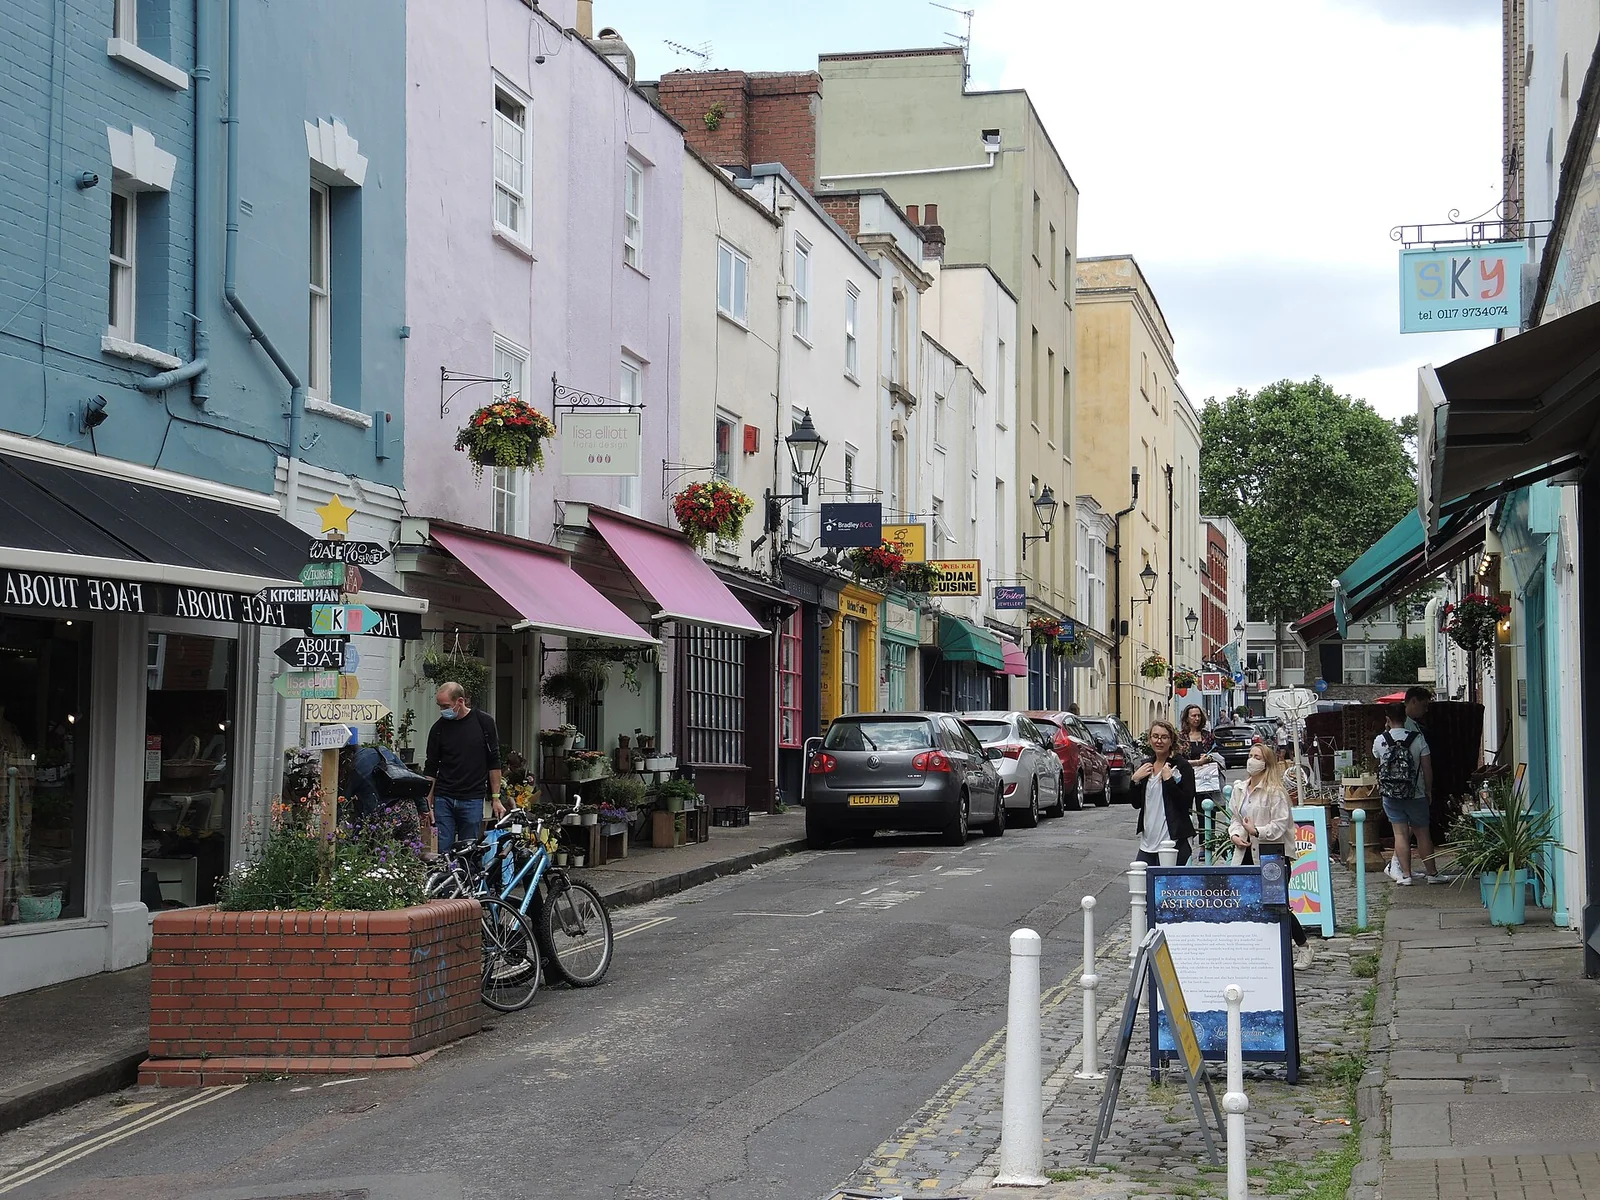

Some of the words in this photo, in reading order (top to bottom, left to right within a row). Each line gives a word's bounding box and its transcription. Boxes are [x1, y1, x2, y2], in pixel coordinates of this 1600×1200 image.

[1418, 310, 1432, 320] tel
[1437, 309, 1458, 319] 0117
[1462, 305, 1508, 318] 9734074
[572, 425, 592, 440] lisa
[595, 425, 628, 440] elliott
[573, 441, 595, 449] floral
[599, 441, 628, 450] design
[937, 571, 973, 581] NDIAN
[4, 572, 79, 608] ABOUT
[996, 588, 1024, 600] Foster
[175, 588, 235, 621] ABOUT
[296, 638, 343, 652] ABOUT
[287, 673, 305, 688] lisa
[308, 672, 336, 689] elliott
[306, 703, 341, 720] FOCUS
[350, 703, 382, 720] PAST
[322, 735, 344, 746] travel
[853, 795, 876, 804] LC07
[877, 795, 895, 804] HBX
[1301, 829, 1315, 842] UP
[1161, 889, 1241, 897] PSYCHOLOGICAL
[1161, 898, 1241, 909] ASTROLOGY
